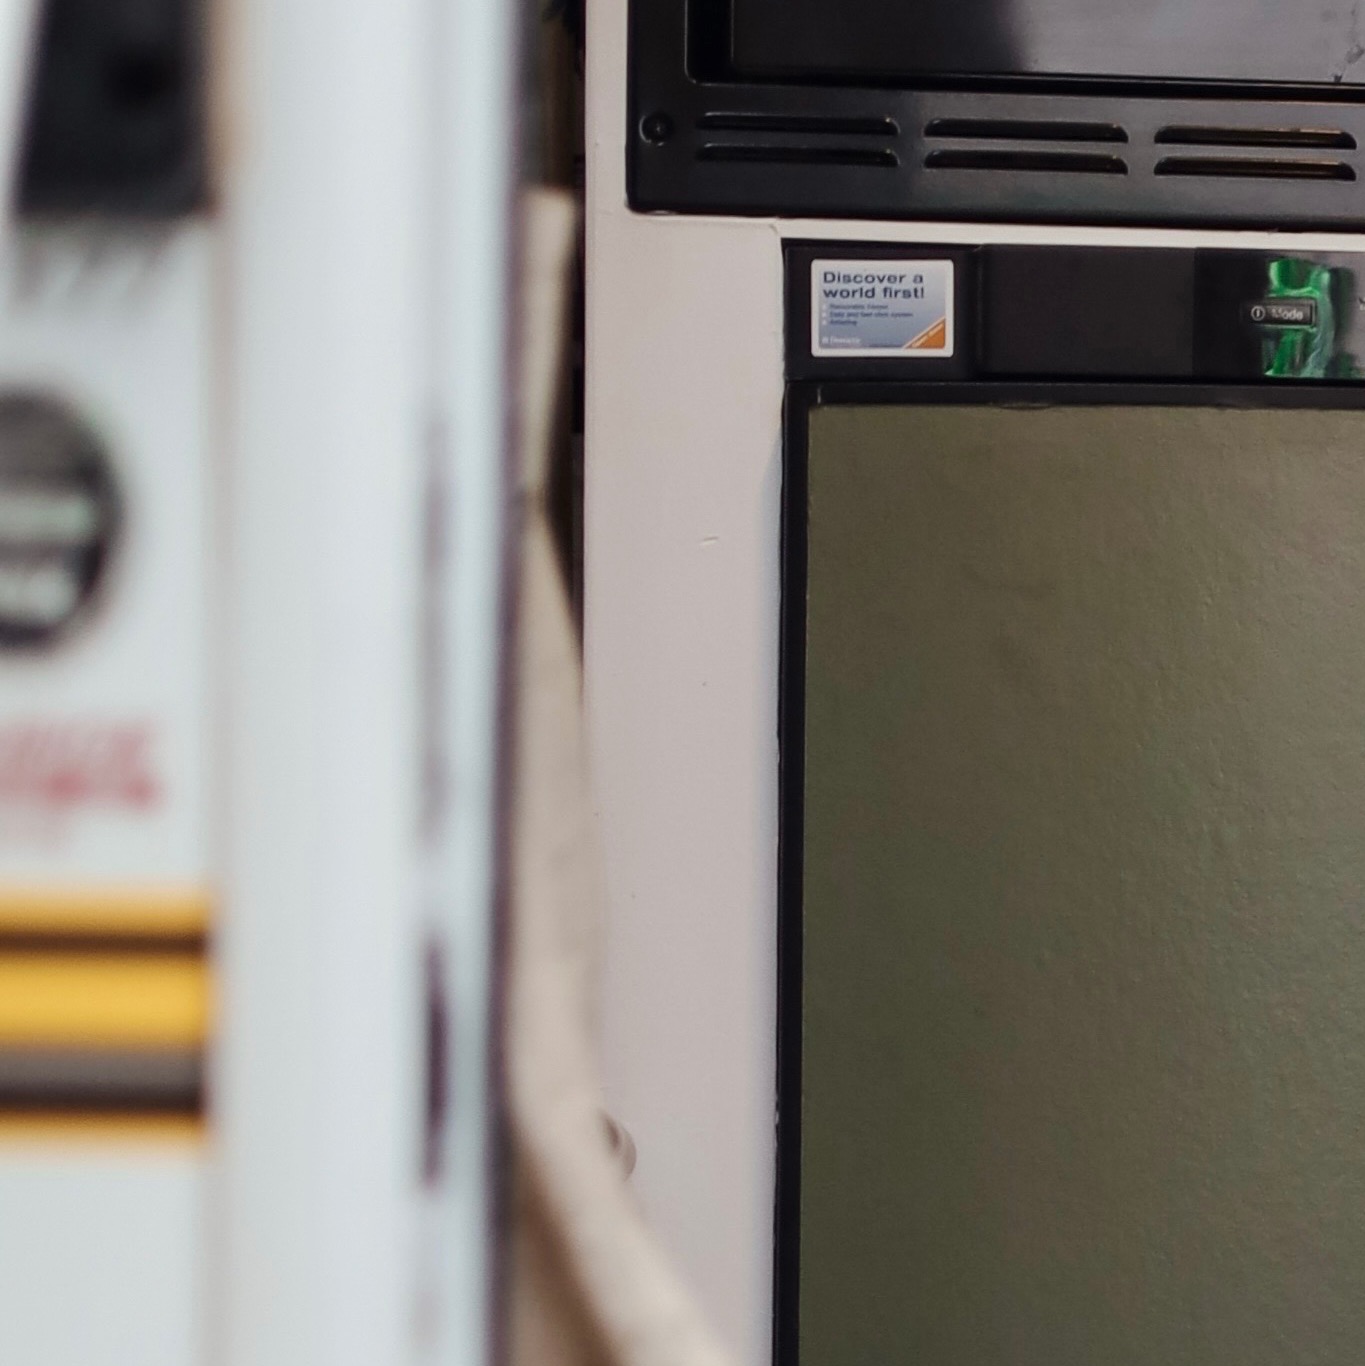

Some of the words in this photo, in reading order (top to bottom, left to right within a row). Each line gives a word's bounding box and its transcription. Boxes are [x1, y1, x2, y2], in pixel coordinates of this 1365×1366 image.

[823, 270, 906, 284] Discover
[912, 274, 923, 284] a
[823, 287, 875, 299] world
[882, 286, 924, 299] first!
